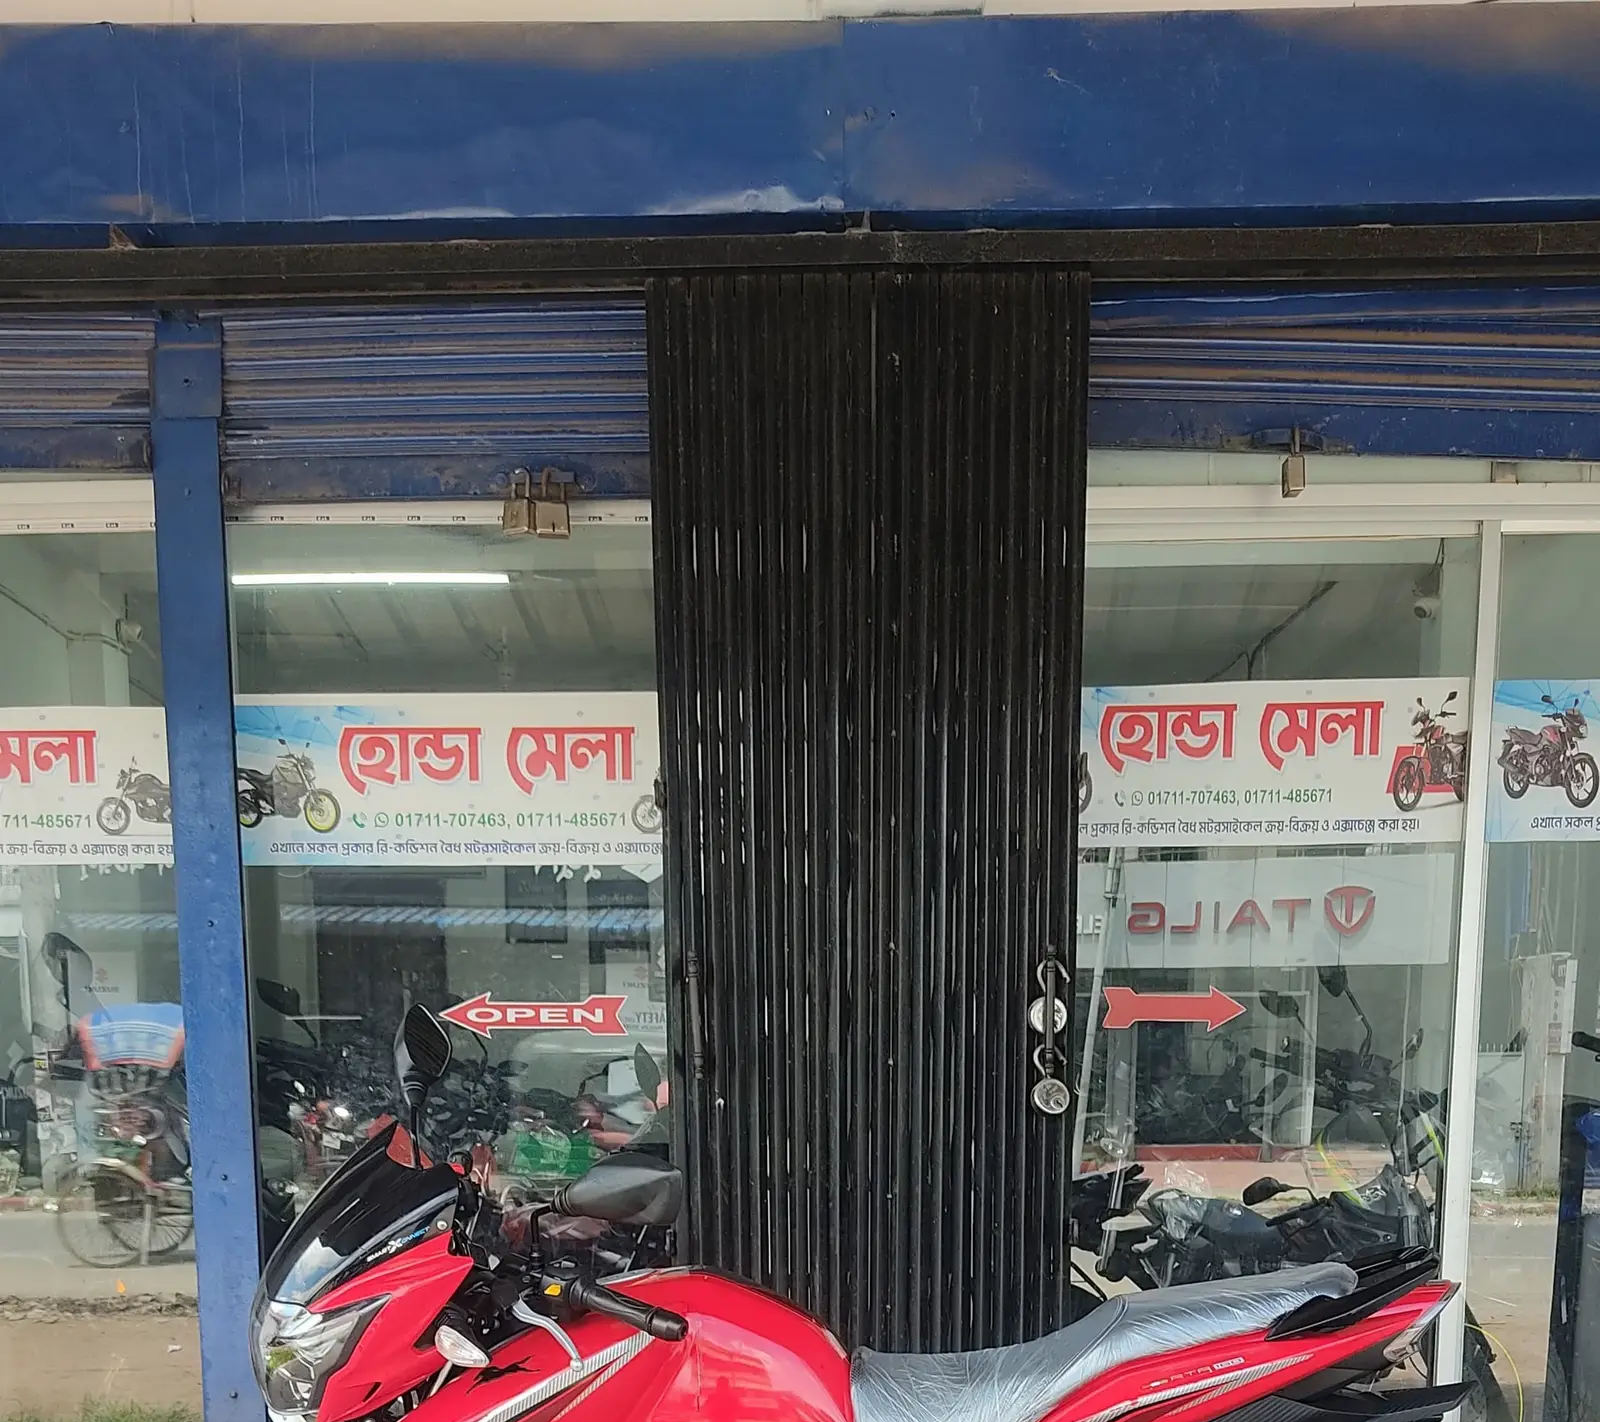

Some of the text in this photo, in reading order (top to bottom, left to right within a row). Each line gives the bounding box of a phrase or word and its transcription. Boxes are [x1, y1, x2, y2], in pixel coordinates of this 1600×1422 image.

[1099, 700, 1385, 774] হোন্ডা মেলা
[338, 726, 636, 797] হোন্ডা মেলা
[1147, 787, 1333, 806] 01711-707463, 01711-485671
[395, 812, 626, 829] 01711-707463, 01711-485671
[1177, 817, 1198, 834] বৈধ
[1321, 819, 1330, 831] ও
[1377, 818, 1400, 832] করা
[1530, 816, 1563, 829] এখানে
[1564, 816, 1594, 829] সকল
[69, 844, 78, 854] ও
[130, 844, 155, 855] করা
[270, 841, 304, 854] এখানে
[306, 841, 339, 854] সকল
[440, 838, 462, 854] বৈধ
[602, 842, 612, 853] ও
[466, 1006, 605, 1024] OPEN
